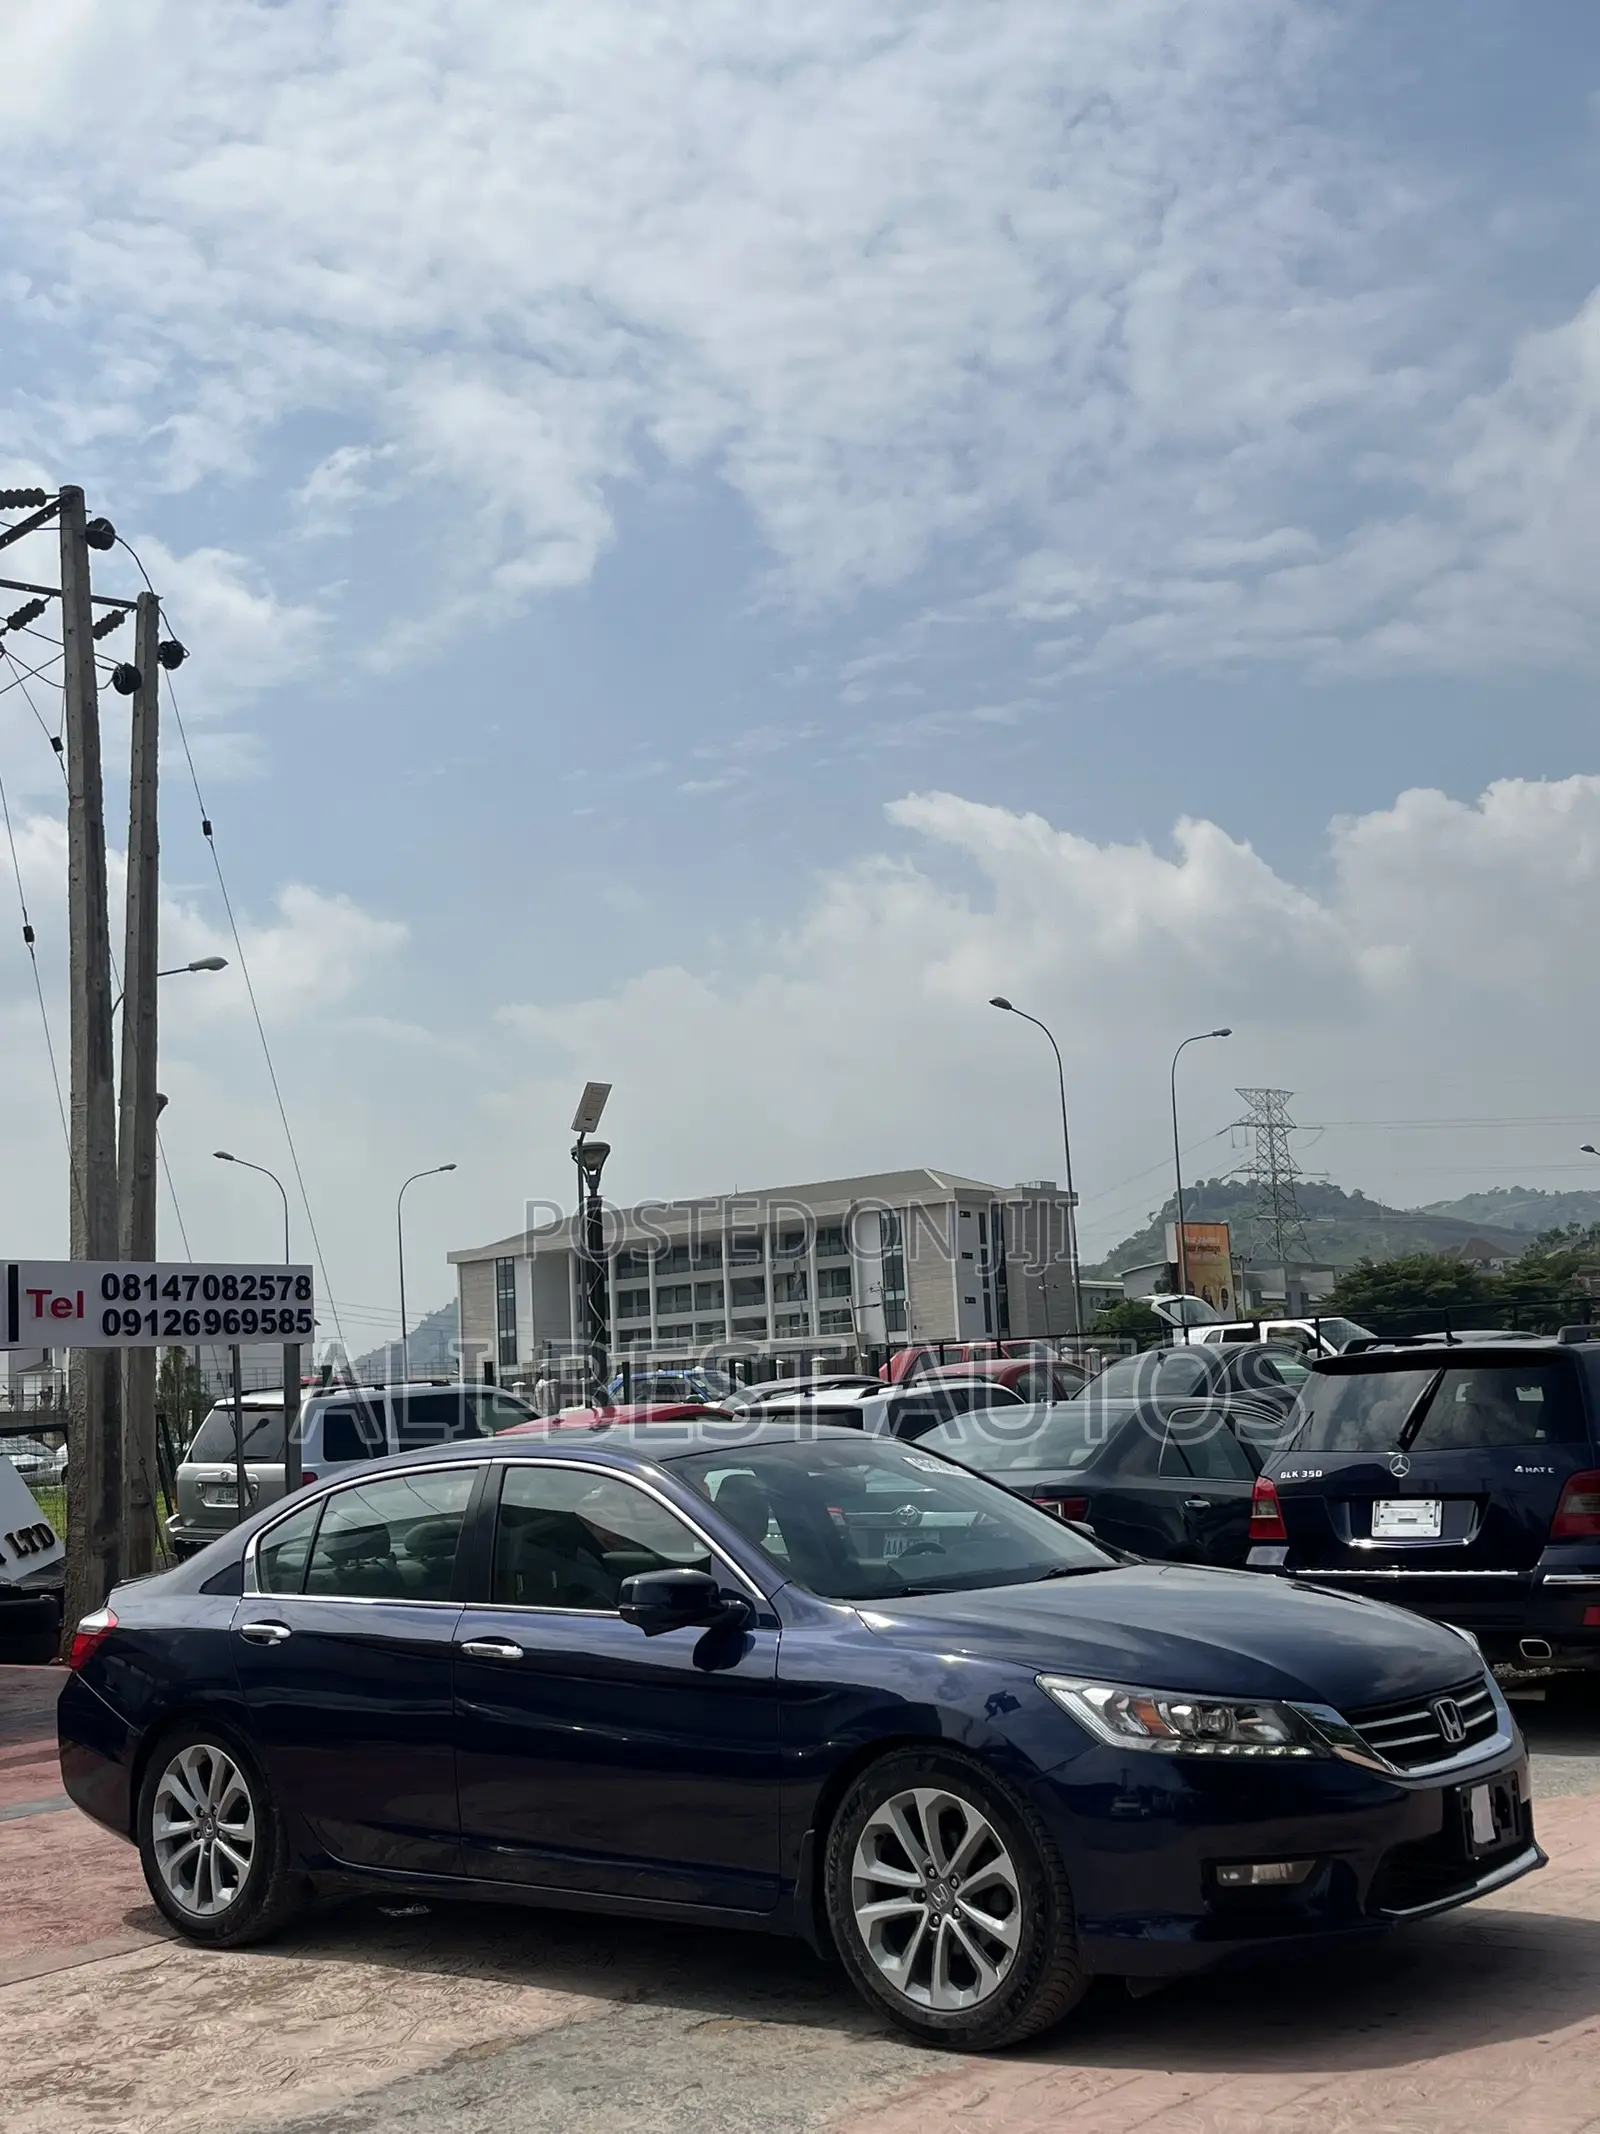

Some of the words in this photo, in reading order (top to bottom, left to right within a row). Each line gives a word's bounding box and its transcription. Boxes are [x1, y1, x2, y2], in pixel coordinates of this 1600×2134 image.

[101, 1273, 312, 1302] 08147082578
[26, 1288, 85, 1319] Tel
[101, 1308, 313, 1337] 09126969585
[1280, 1470, 1299, 1479] GLK
[1301, 1469, 1323, 1478] 350
[3, 1522, 56, 1559] LTD
